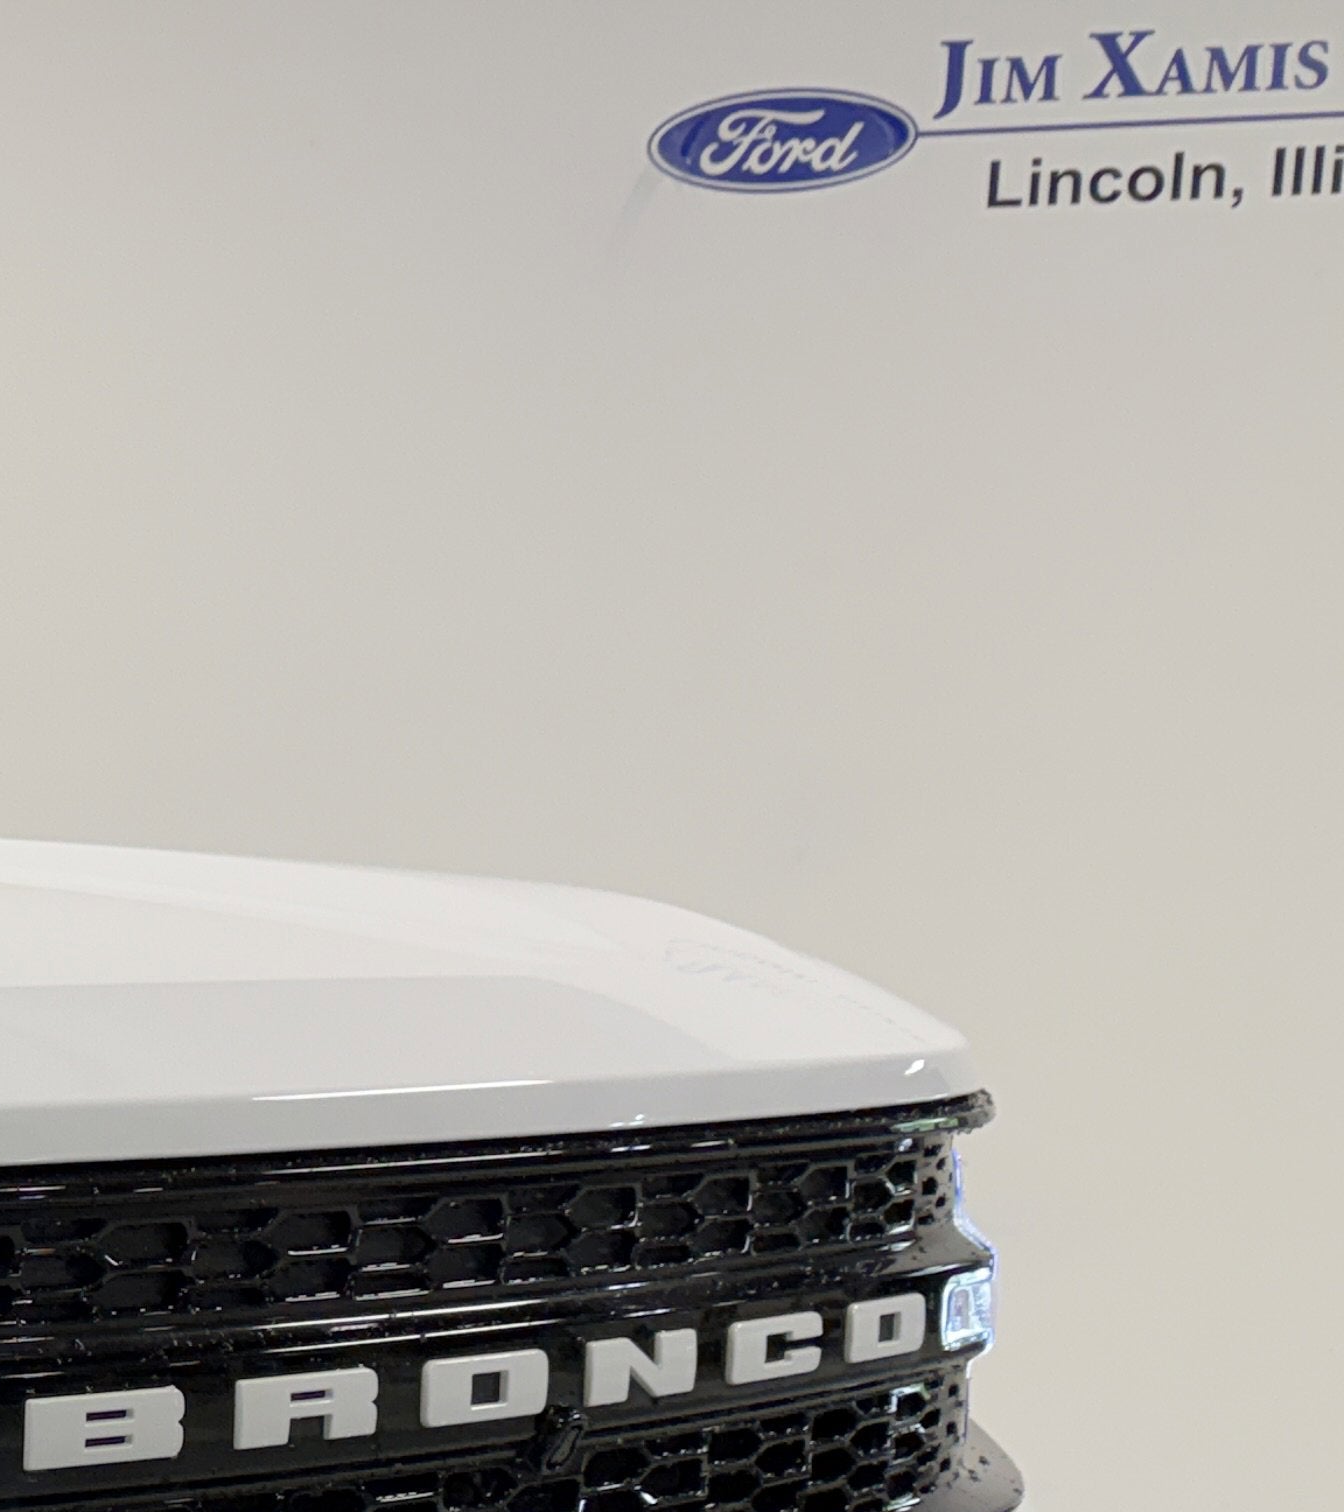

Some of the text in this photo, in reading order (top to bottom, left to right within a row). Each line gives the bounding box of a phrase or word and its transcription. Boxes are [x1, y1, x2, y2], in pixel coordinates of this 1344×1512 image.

[932, 28, 1330, 120] JIM XAMIS
[699, 107, 859, 176] Ford
[986, 150, 1244, 209] Lincoln,
[23, 1292, 925, 1472] BRONCO
